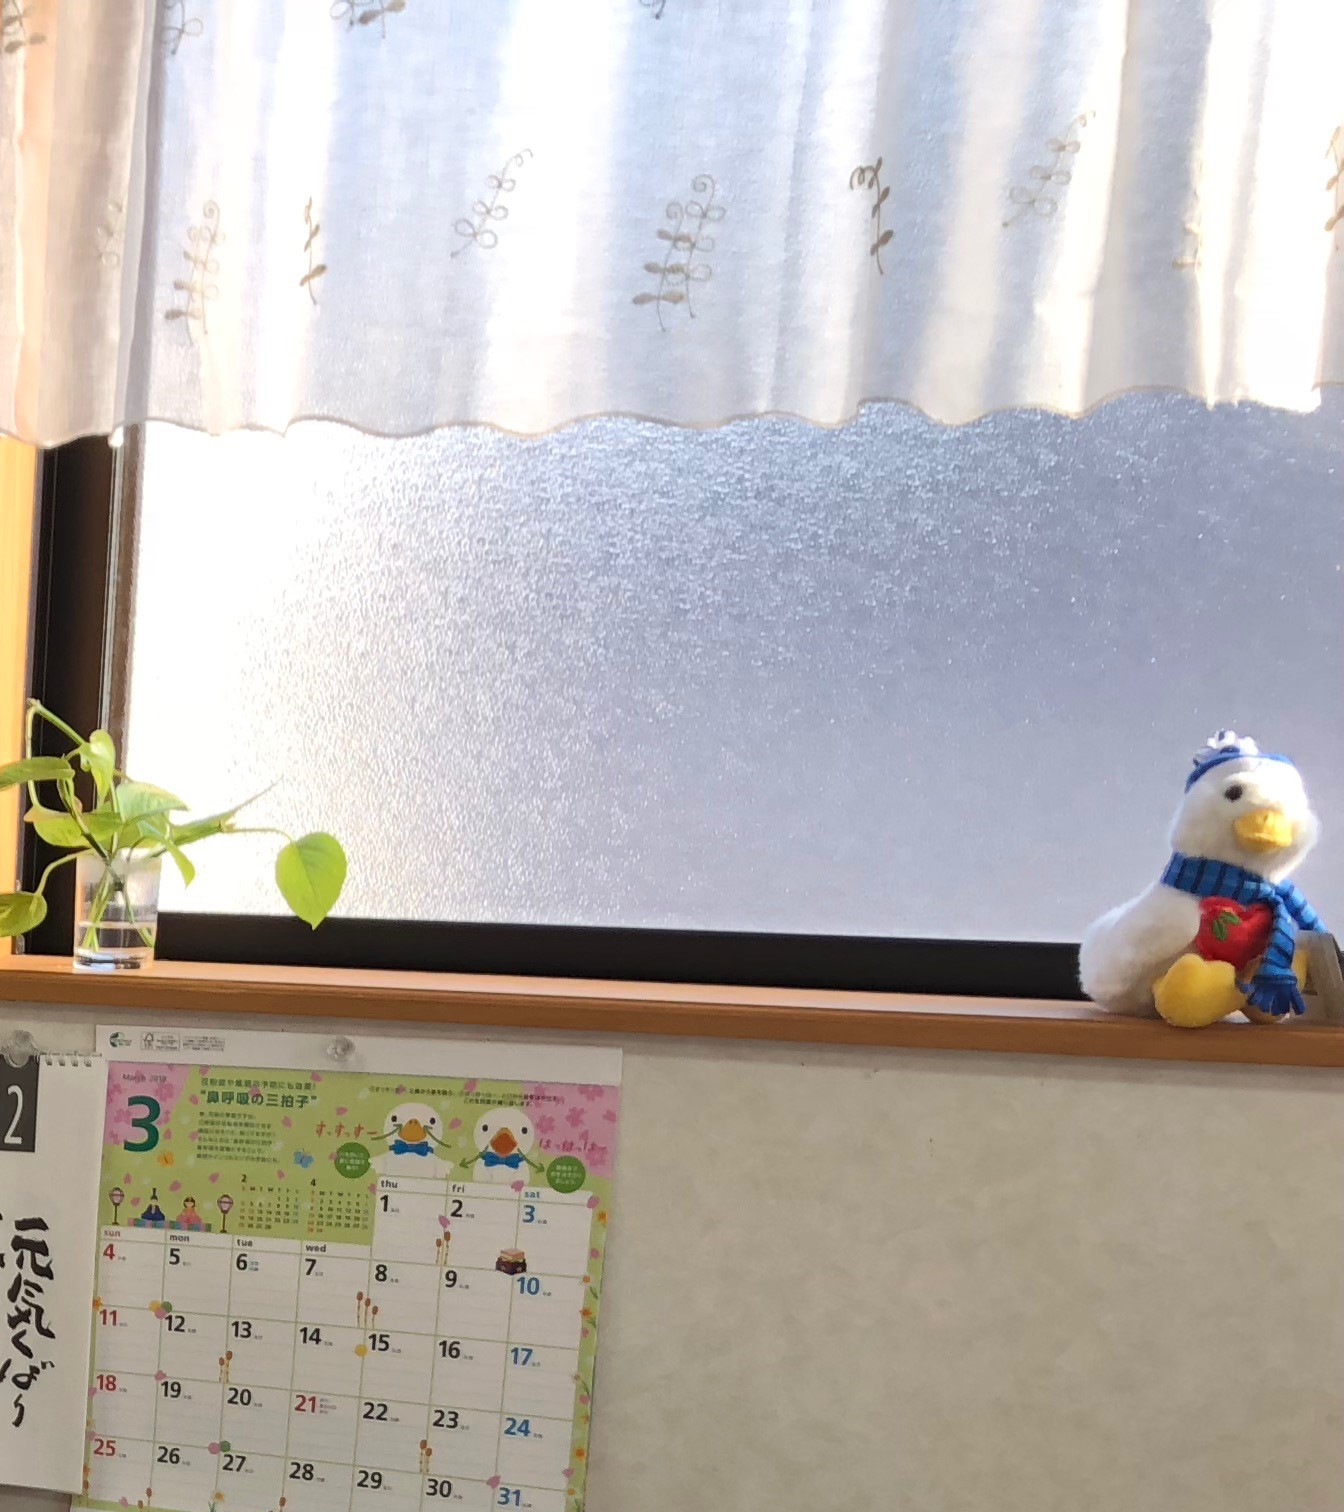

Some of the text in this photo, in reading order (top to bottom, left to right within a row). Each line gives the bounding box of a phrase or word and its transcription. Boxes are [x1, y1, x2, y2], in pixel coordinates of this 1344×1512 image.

[3, 1085, 24, 1145] 2
[124, 1096, 160, 1152] 3
[380, 1195, 535, 1223] 1 2 3
[381, 1180, 540, 1198] thu fri sat
[103, 1243, 115, 1260] 4
[169, 1248, 180, 1265] 5
[236, 1254, 247, 1270] 6
[305, 1258, 316, 1275] 7
[375, 1264, 387, 1282] 8
[445, 1270, 457, 1288] 9
[517, 1277, 539, 1295] 10
[104, 1230, 121, 1238] sun
[237, 1239, 253, 1247] tue
[306, 1244, 326, 1252] wed
[99, 1309, 533, 1365] 11 12 13 14 15 16 17
[97, 1374, 116, 1391] 18
[161, 1381, 181, 1398] 19
[227, 1388, 251, 1405] 20
[295, 1395, 317, 1413] 21
[363, 1402, 388, 1421] 22
[433, 1410, 459, 1429] 23
[504, 1418, 530, 1437] 24
[94, 1439, 521, 1506] 25 26 27 28 29 30 31
